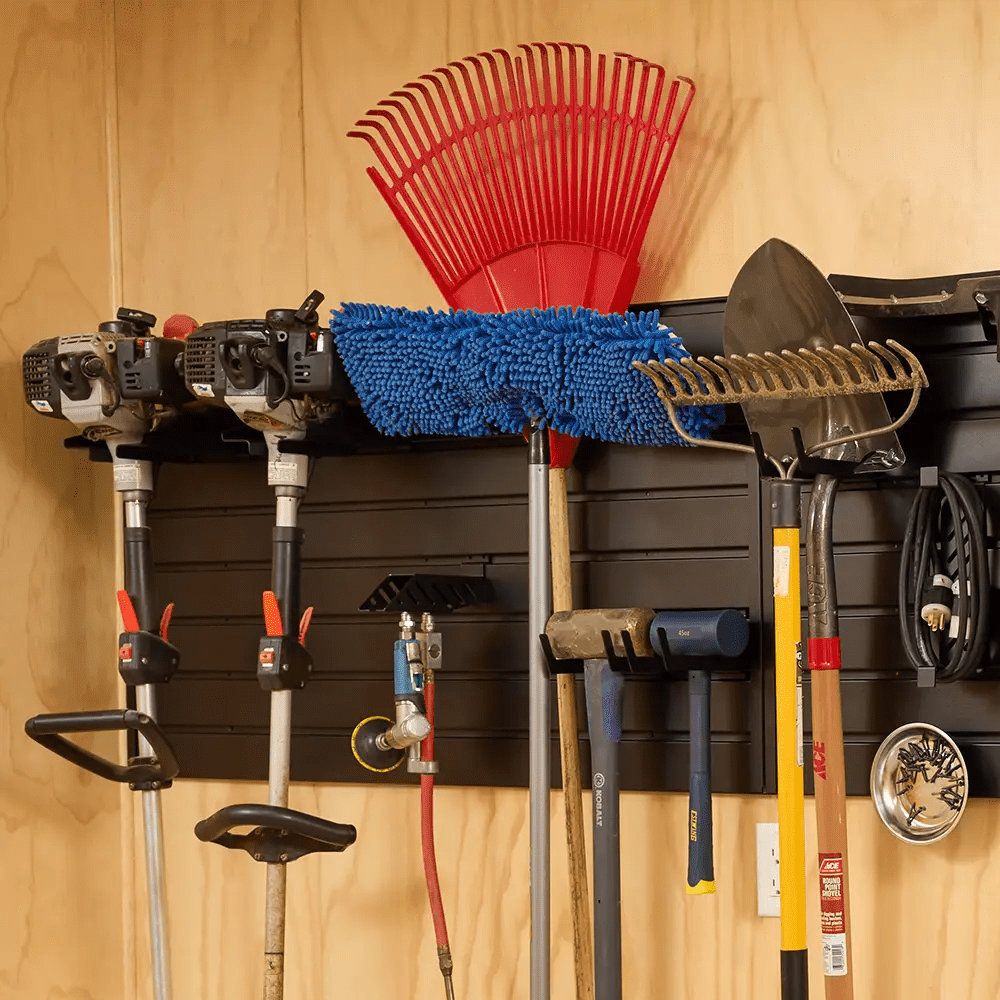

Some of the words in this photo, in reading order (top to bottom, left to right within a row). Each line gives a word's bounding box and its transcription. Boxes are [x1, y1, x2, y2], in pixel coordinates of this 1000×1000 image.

[806, 565, 828, 625] ACE
[813, 741, 827, 780] ACE
[595, 789, 603, 827] KOBALT
[824, 862, 840, 870] ACE
[821, 889, 842, 897] SHOVEL
